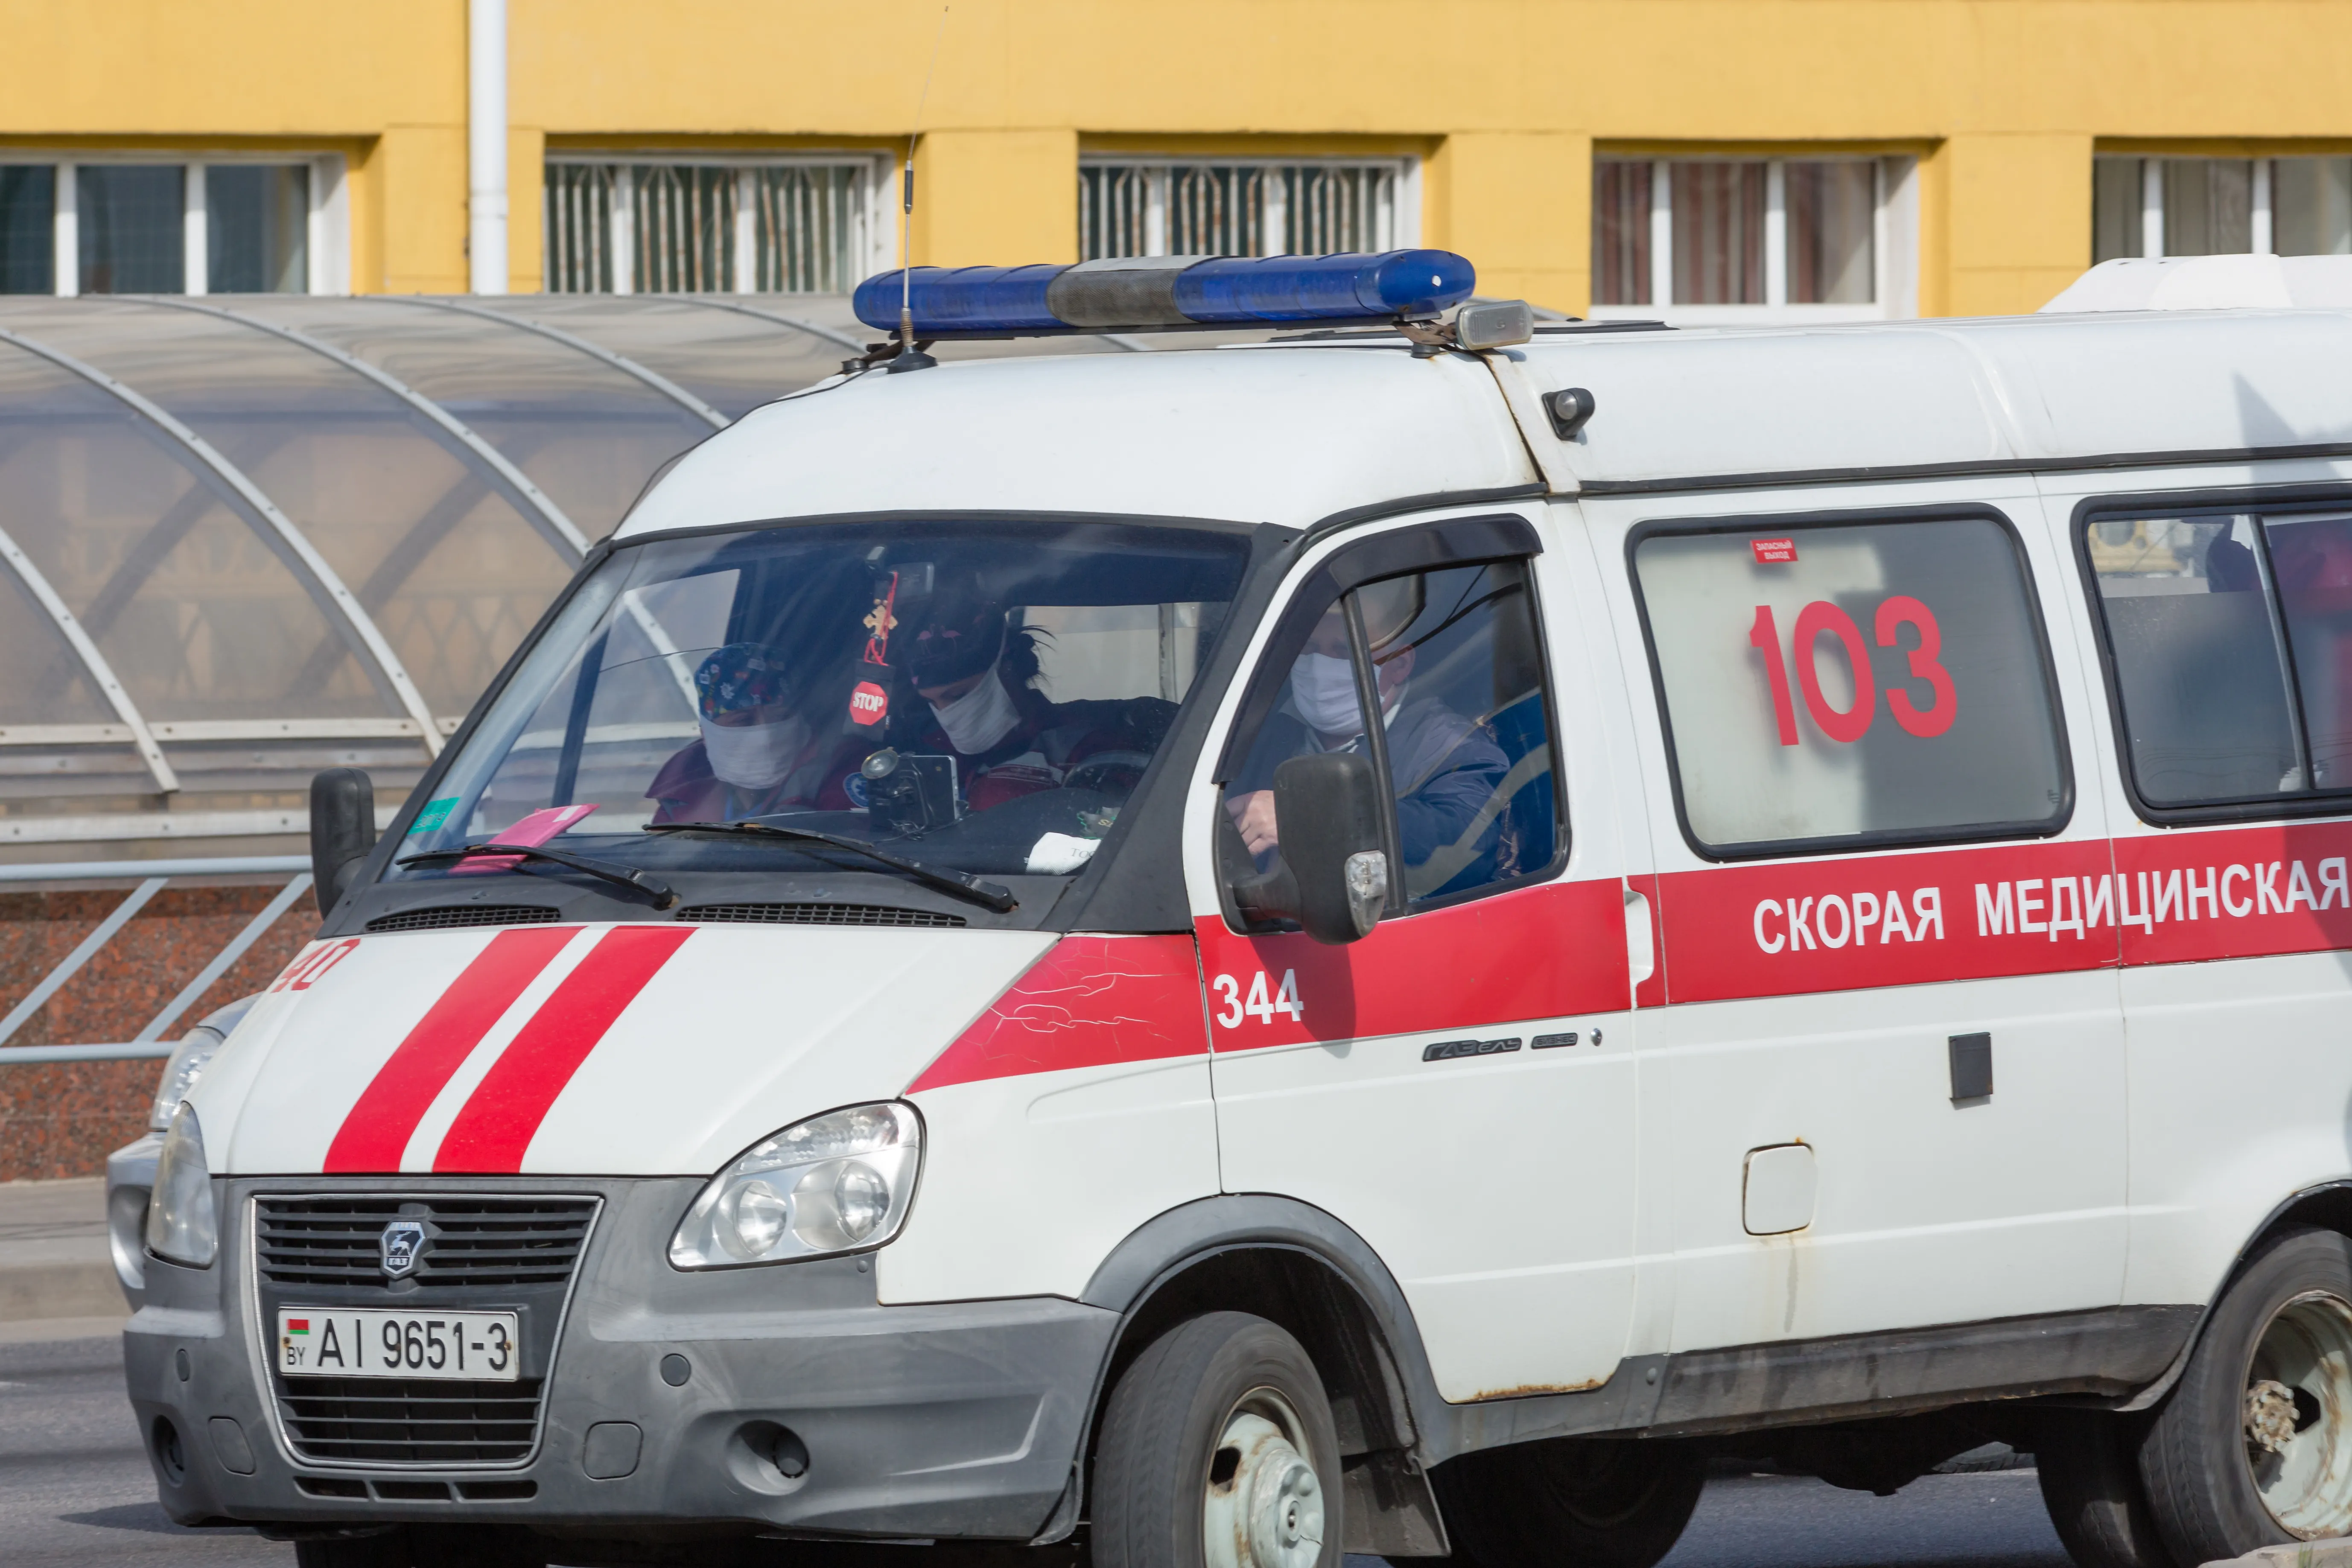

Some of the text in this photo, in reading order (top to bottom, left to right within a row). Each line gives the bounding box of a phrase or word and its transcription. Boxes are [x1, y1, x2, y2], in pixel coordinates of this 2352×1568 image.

[1755, 540, 1792, 550] ЗАПАСНЫЙ
[1764, 551, 1790, 560] ВЫХОД
[1749, 596, 1957, 746] 103
[853, 692, 884, 712] STOP
[1754, 856, 2350, 954] СКОРАЯ МЕДИЦИНСКАЯ
[1213, 968, 1304, 1028] 344
[1537, 1035, 1575, 1045] БИЗНЕС
[318, 1318, 508, 1371] AI 9651-3
[287, 1346, 306, 1366] BY
